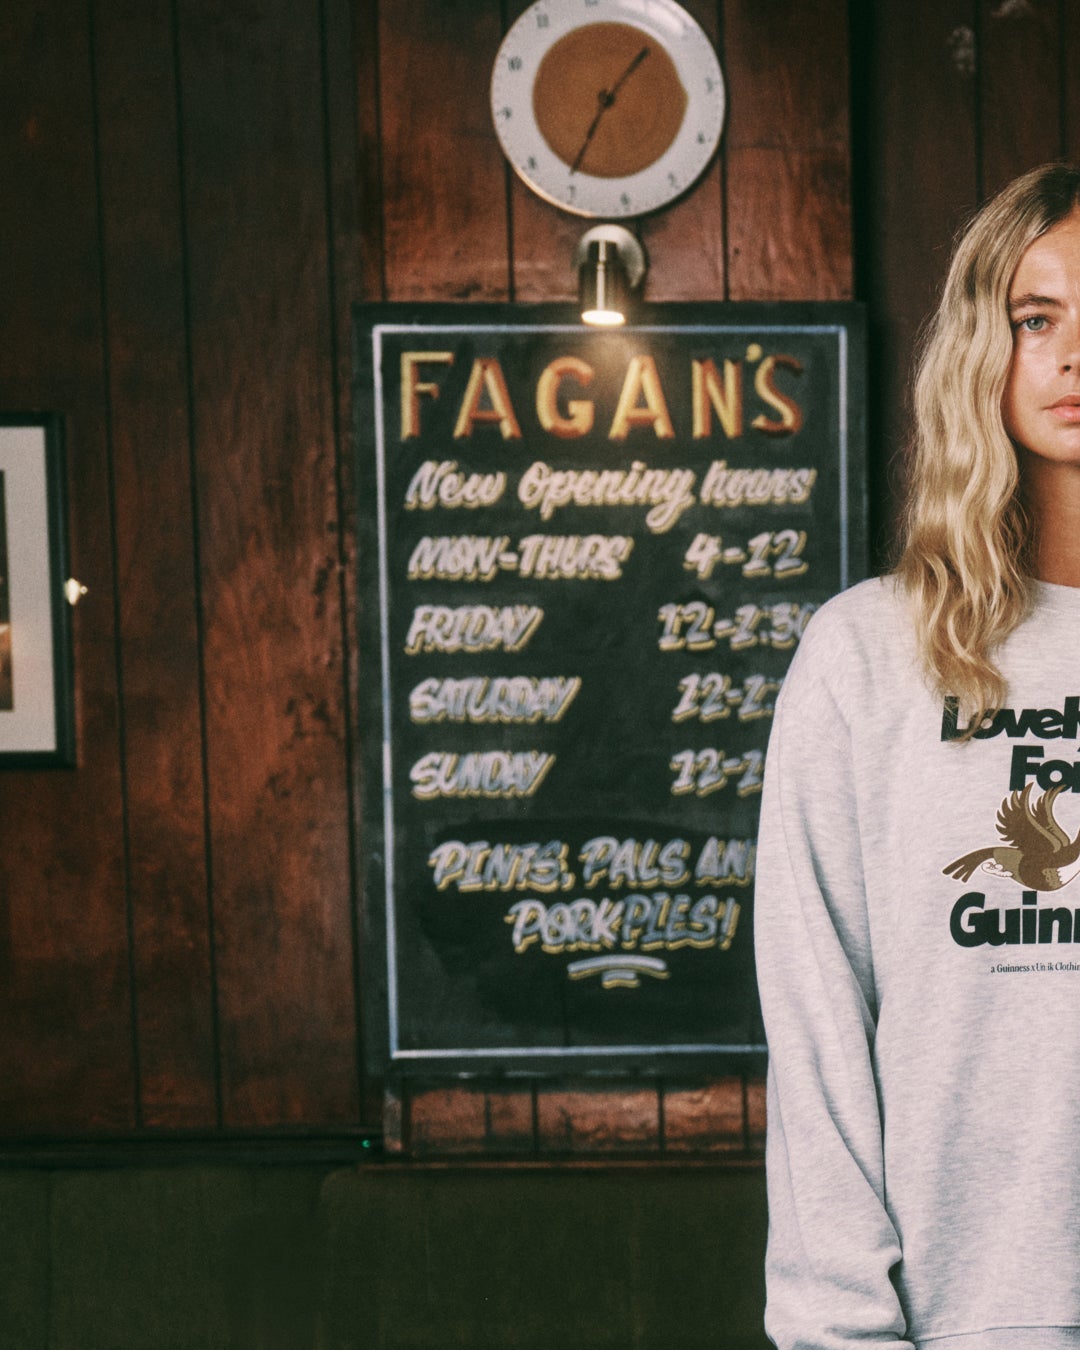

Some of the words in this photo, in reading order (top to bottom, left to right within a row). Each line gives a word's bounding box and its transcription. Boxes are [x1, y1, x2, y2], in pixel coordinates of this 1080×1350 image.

[400, 343, 805, 440] FAGAN'S
[404, 460, 506, 510] New
[517, 460, 697, 533] Opening
[699, 460, 817, 508] hours
[407, 534, 633, 581] MON-THURS
[683, 529, 809, 580] 4-12
[404, 604, 544, 653] FRIDAY
[408, 676, 582, 723] SATURDAY
[408, 751, 556, 798] SUNDAY
[577, 836, 691, 889] PALS
[695, 836, 757, 887] AN
[504, 898, 624, 954] PORK
[996, 963, 1030, 973] Guinness
